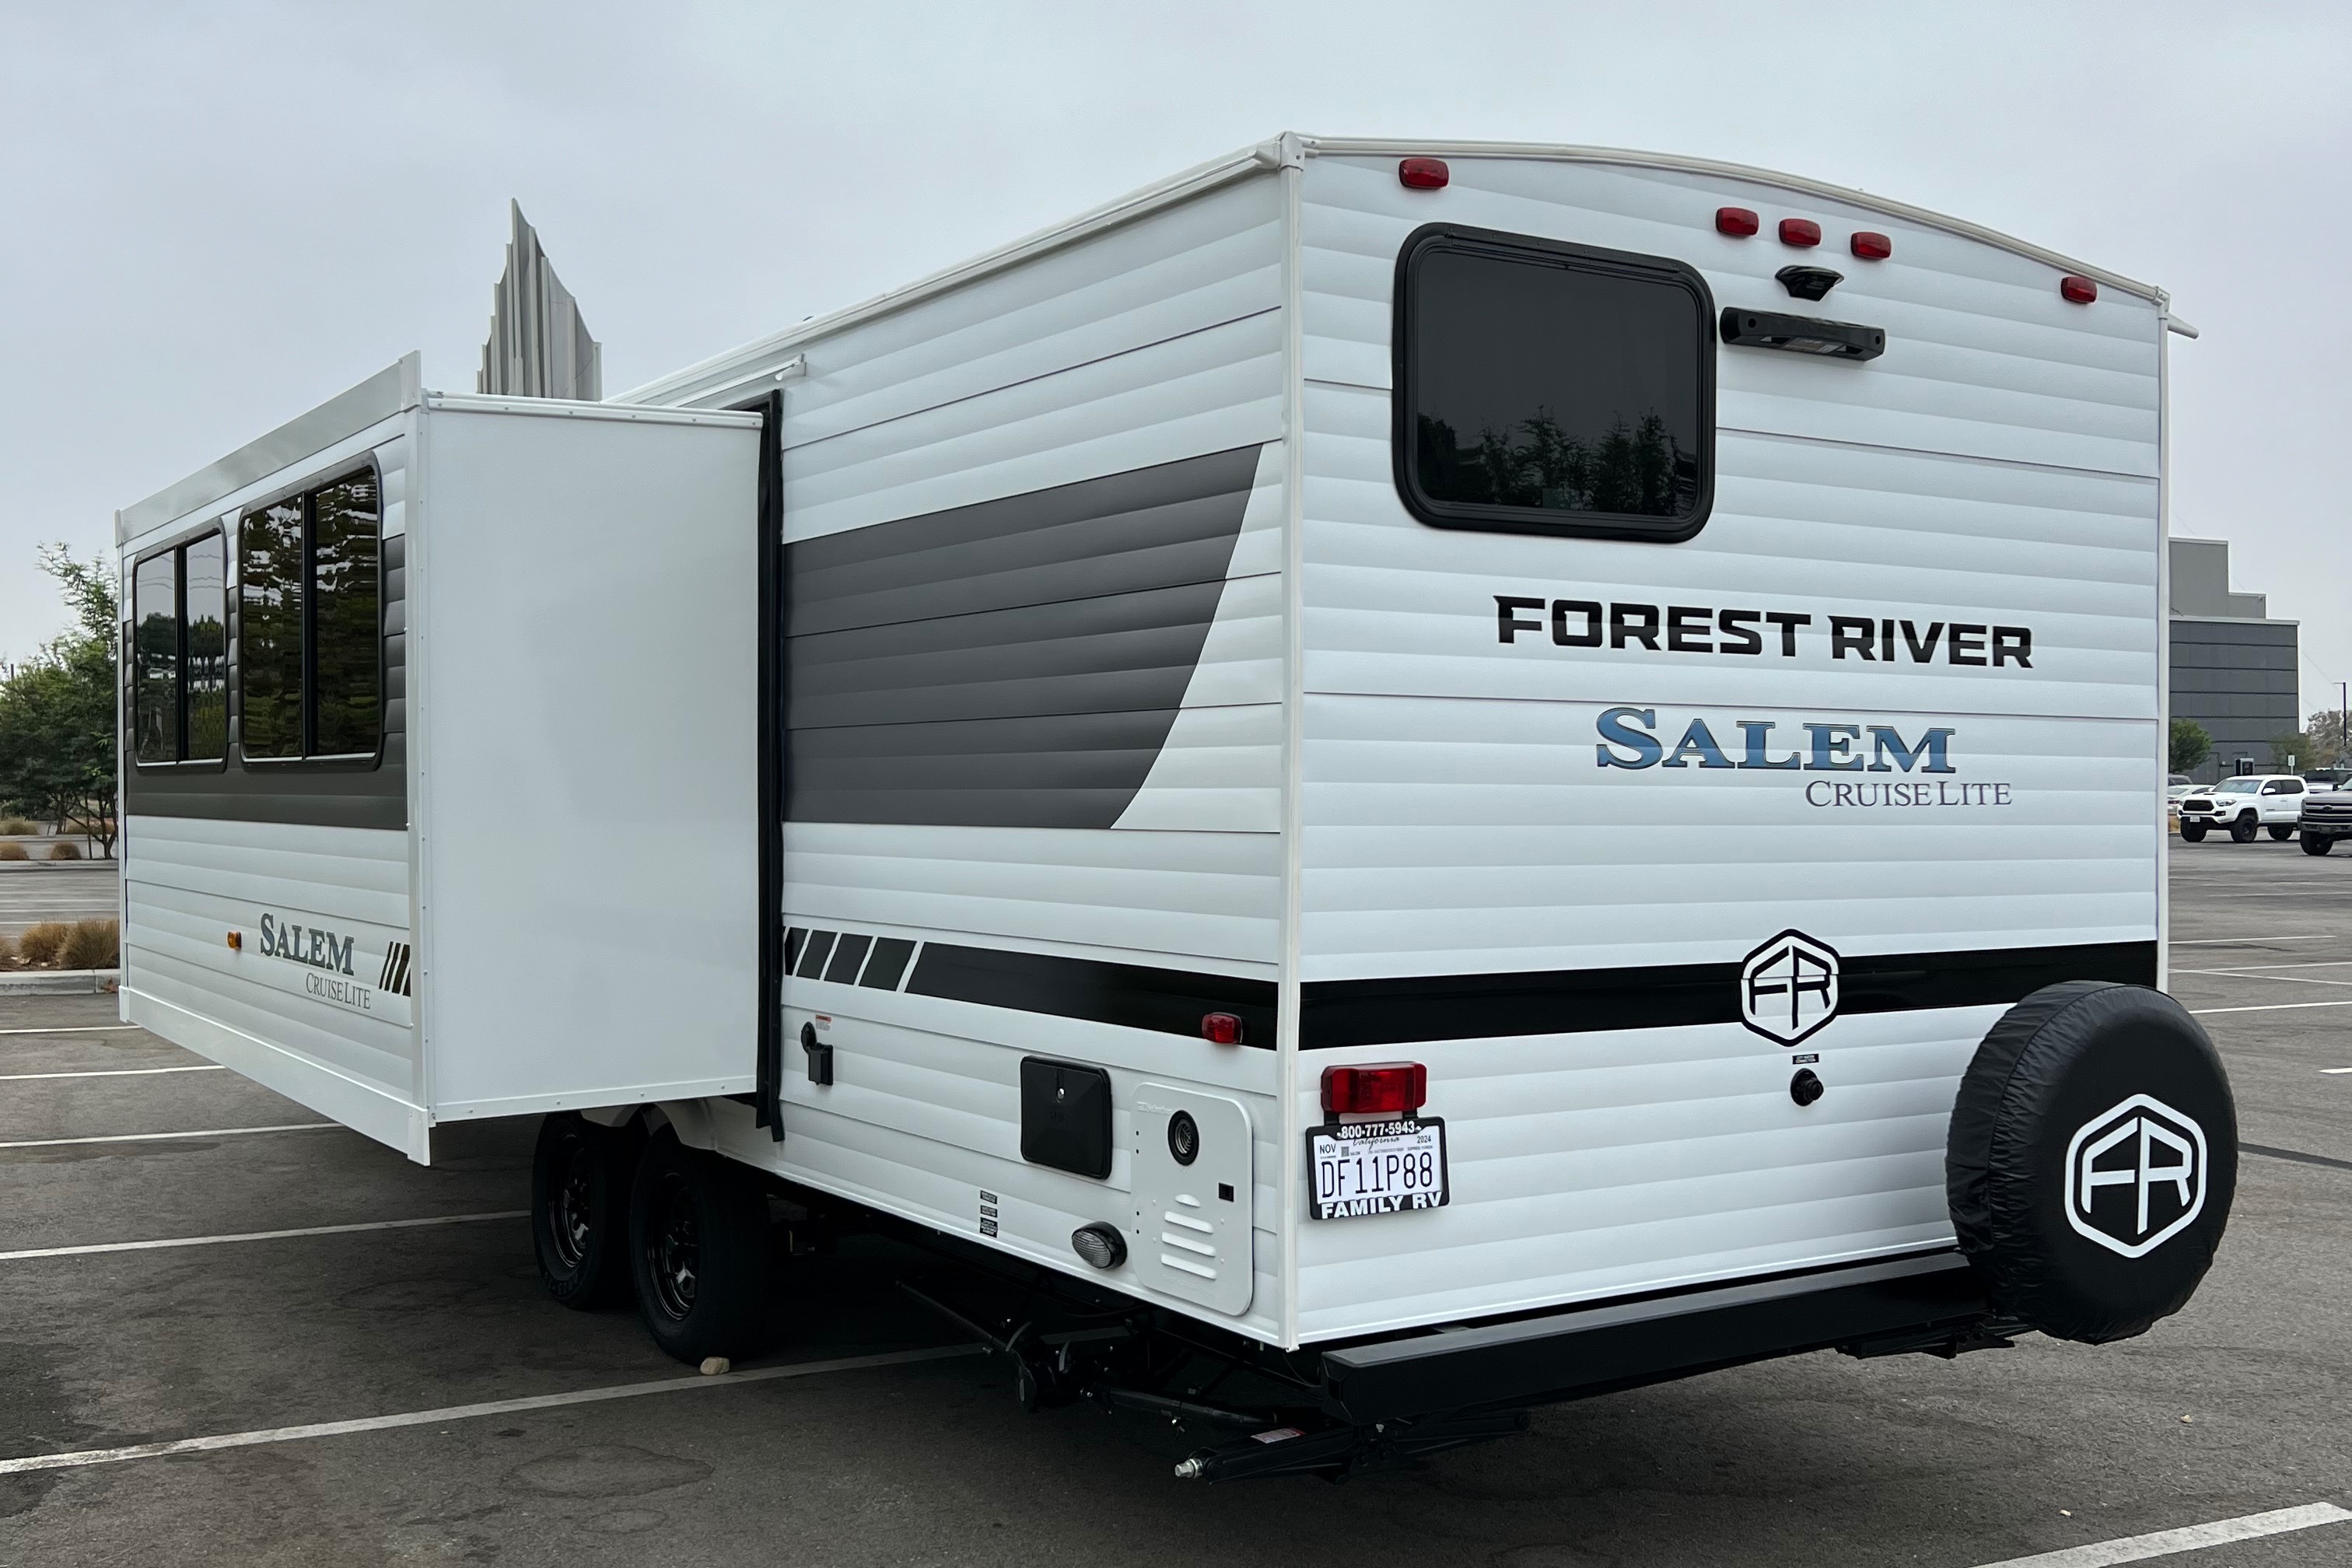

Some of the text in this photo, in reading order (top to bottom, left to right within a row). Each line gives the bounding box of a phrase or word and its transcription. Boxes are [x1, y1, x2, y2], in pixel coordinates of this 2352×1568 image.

[1493, 594, 2034, 670] FOREST RIVER
[1595, 706, 1957, 774] SALEM
[260, 912, 355, 975] SALEM
[1319, 1143, 1336, 1154] NOV
[1416, 1135, 1432, 1144] 2024
[1321, 1152, 1432, 1198] DF11P88
[1321, 1191, 1443, 1220] FAMILY RV
